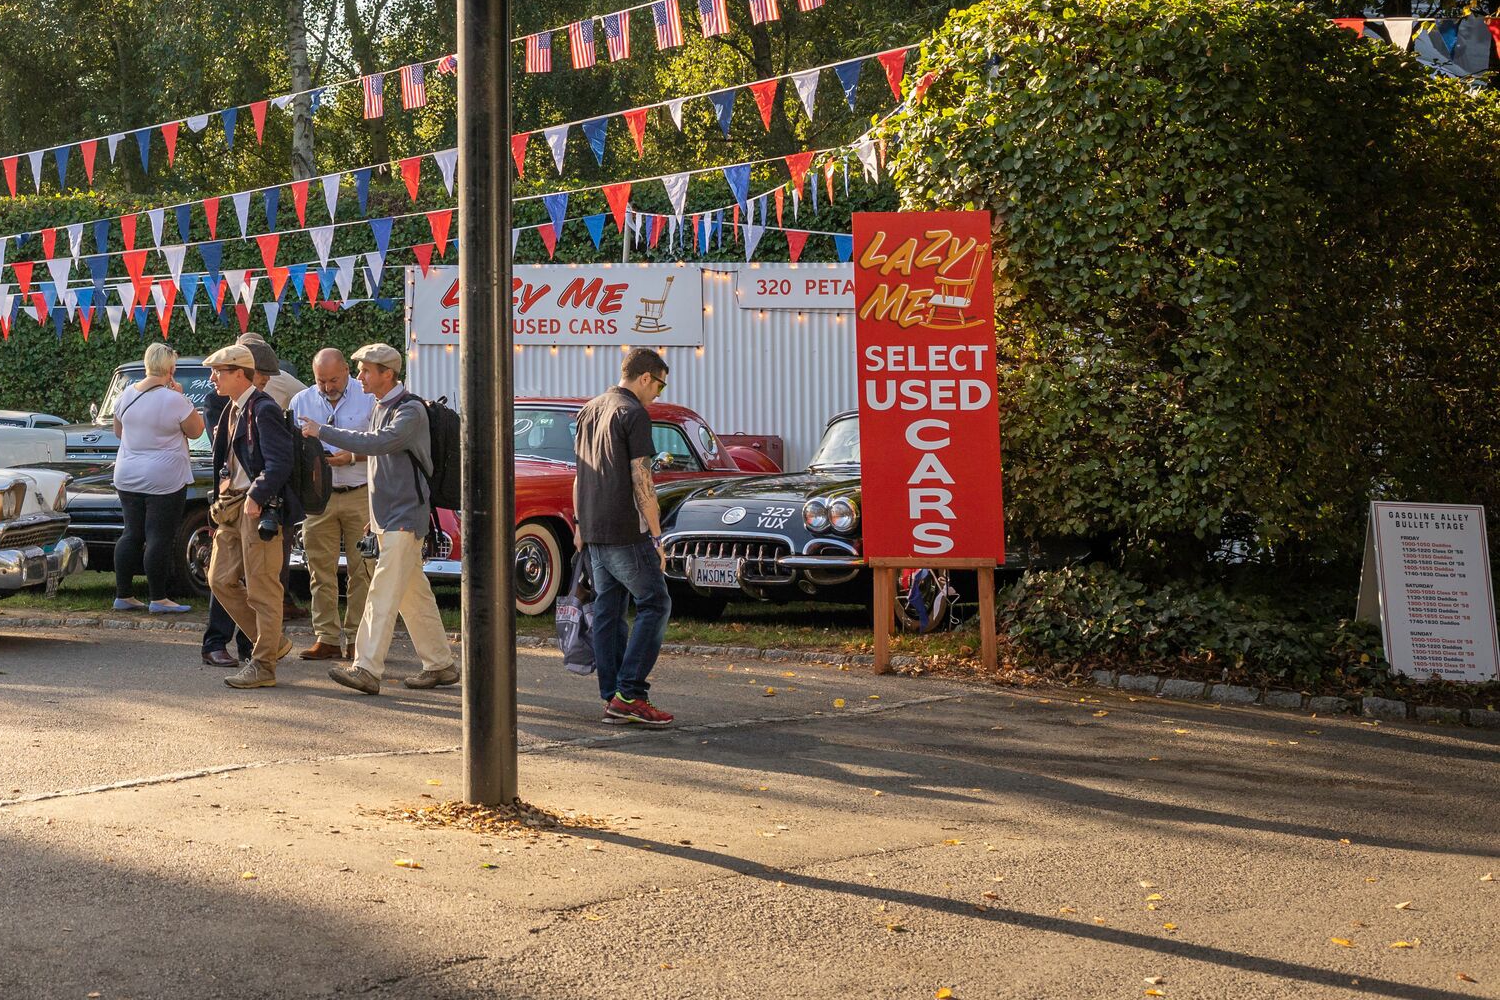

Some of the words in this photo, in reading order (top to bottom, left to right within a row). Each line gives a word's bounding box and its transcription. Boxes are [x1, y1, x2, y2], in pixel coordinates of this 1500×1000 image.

[859, 229, 977, 277] LAZY
[440, 277, 551, 315] LY
[557, 277, 629, 315] ME
[756, 279, 792, 296] 320
[859, 284, 936, 328] ME
[513, 318, 561, 335] USED
[569, 318, 618, 335] CARS
[865, 345, 988, 372] SELECT
[865, 379, 992, 411] USED
[905, 418, 957, 555] CARS
[761, 506, 795, 517] 323
[1388, 512, 1435, 520] GASOLINE
[756, 516, 788, 529] YUX
[1395, 521, 1429, 529] BULLET
[1435, 522, 1464, 530] STAGE
[696, 569, 726, 583] AWSOM
